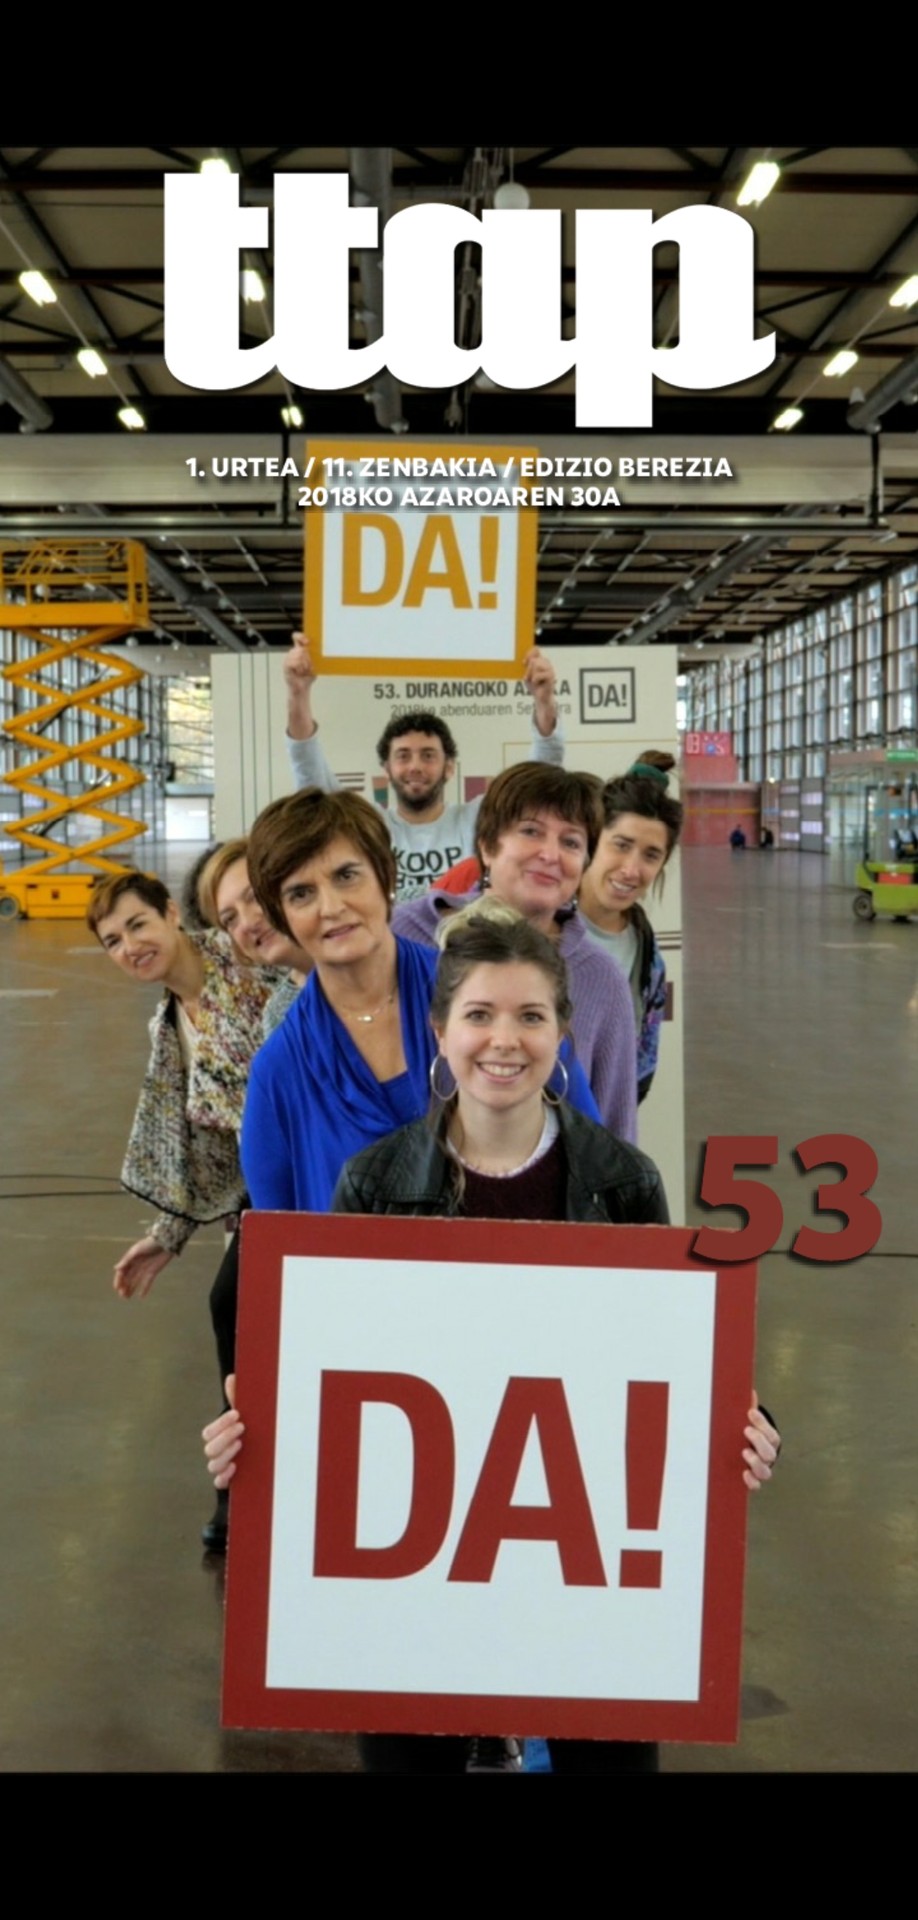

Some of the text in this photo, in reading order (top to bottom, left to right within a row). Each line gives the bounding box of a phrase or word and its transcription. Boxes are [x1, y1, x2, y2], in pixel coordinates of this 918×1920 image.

[340, 512, 501, 611] DA!
[373, 682, 401, 700] 53.
[405, 680, 508, 699] DURANGOKO
[587, 683, 629, 708] DA!
[440, 702, 513, 717] abenduaren
[312, 1368, 671, 1590] DA!
